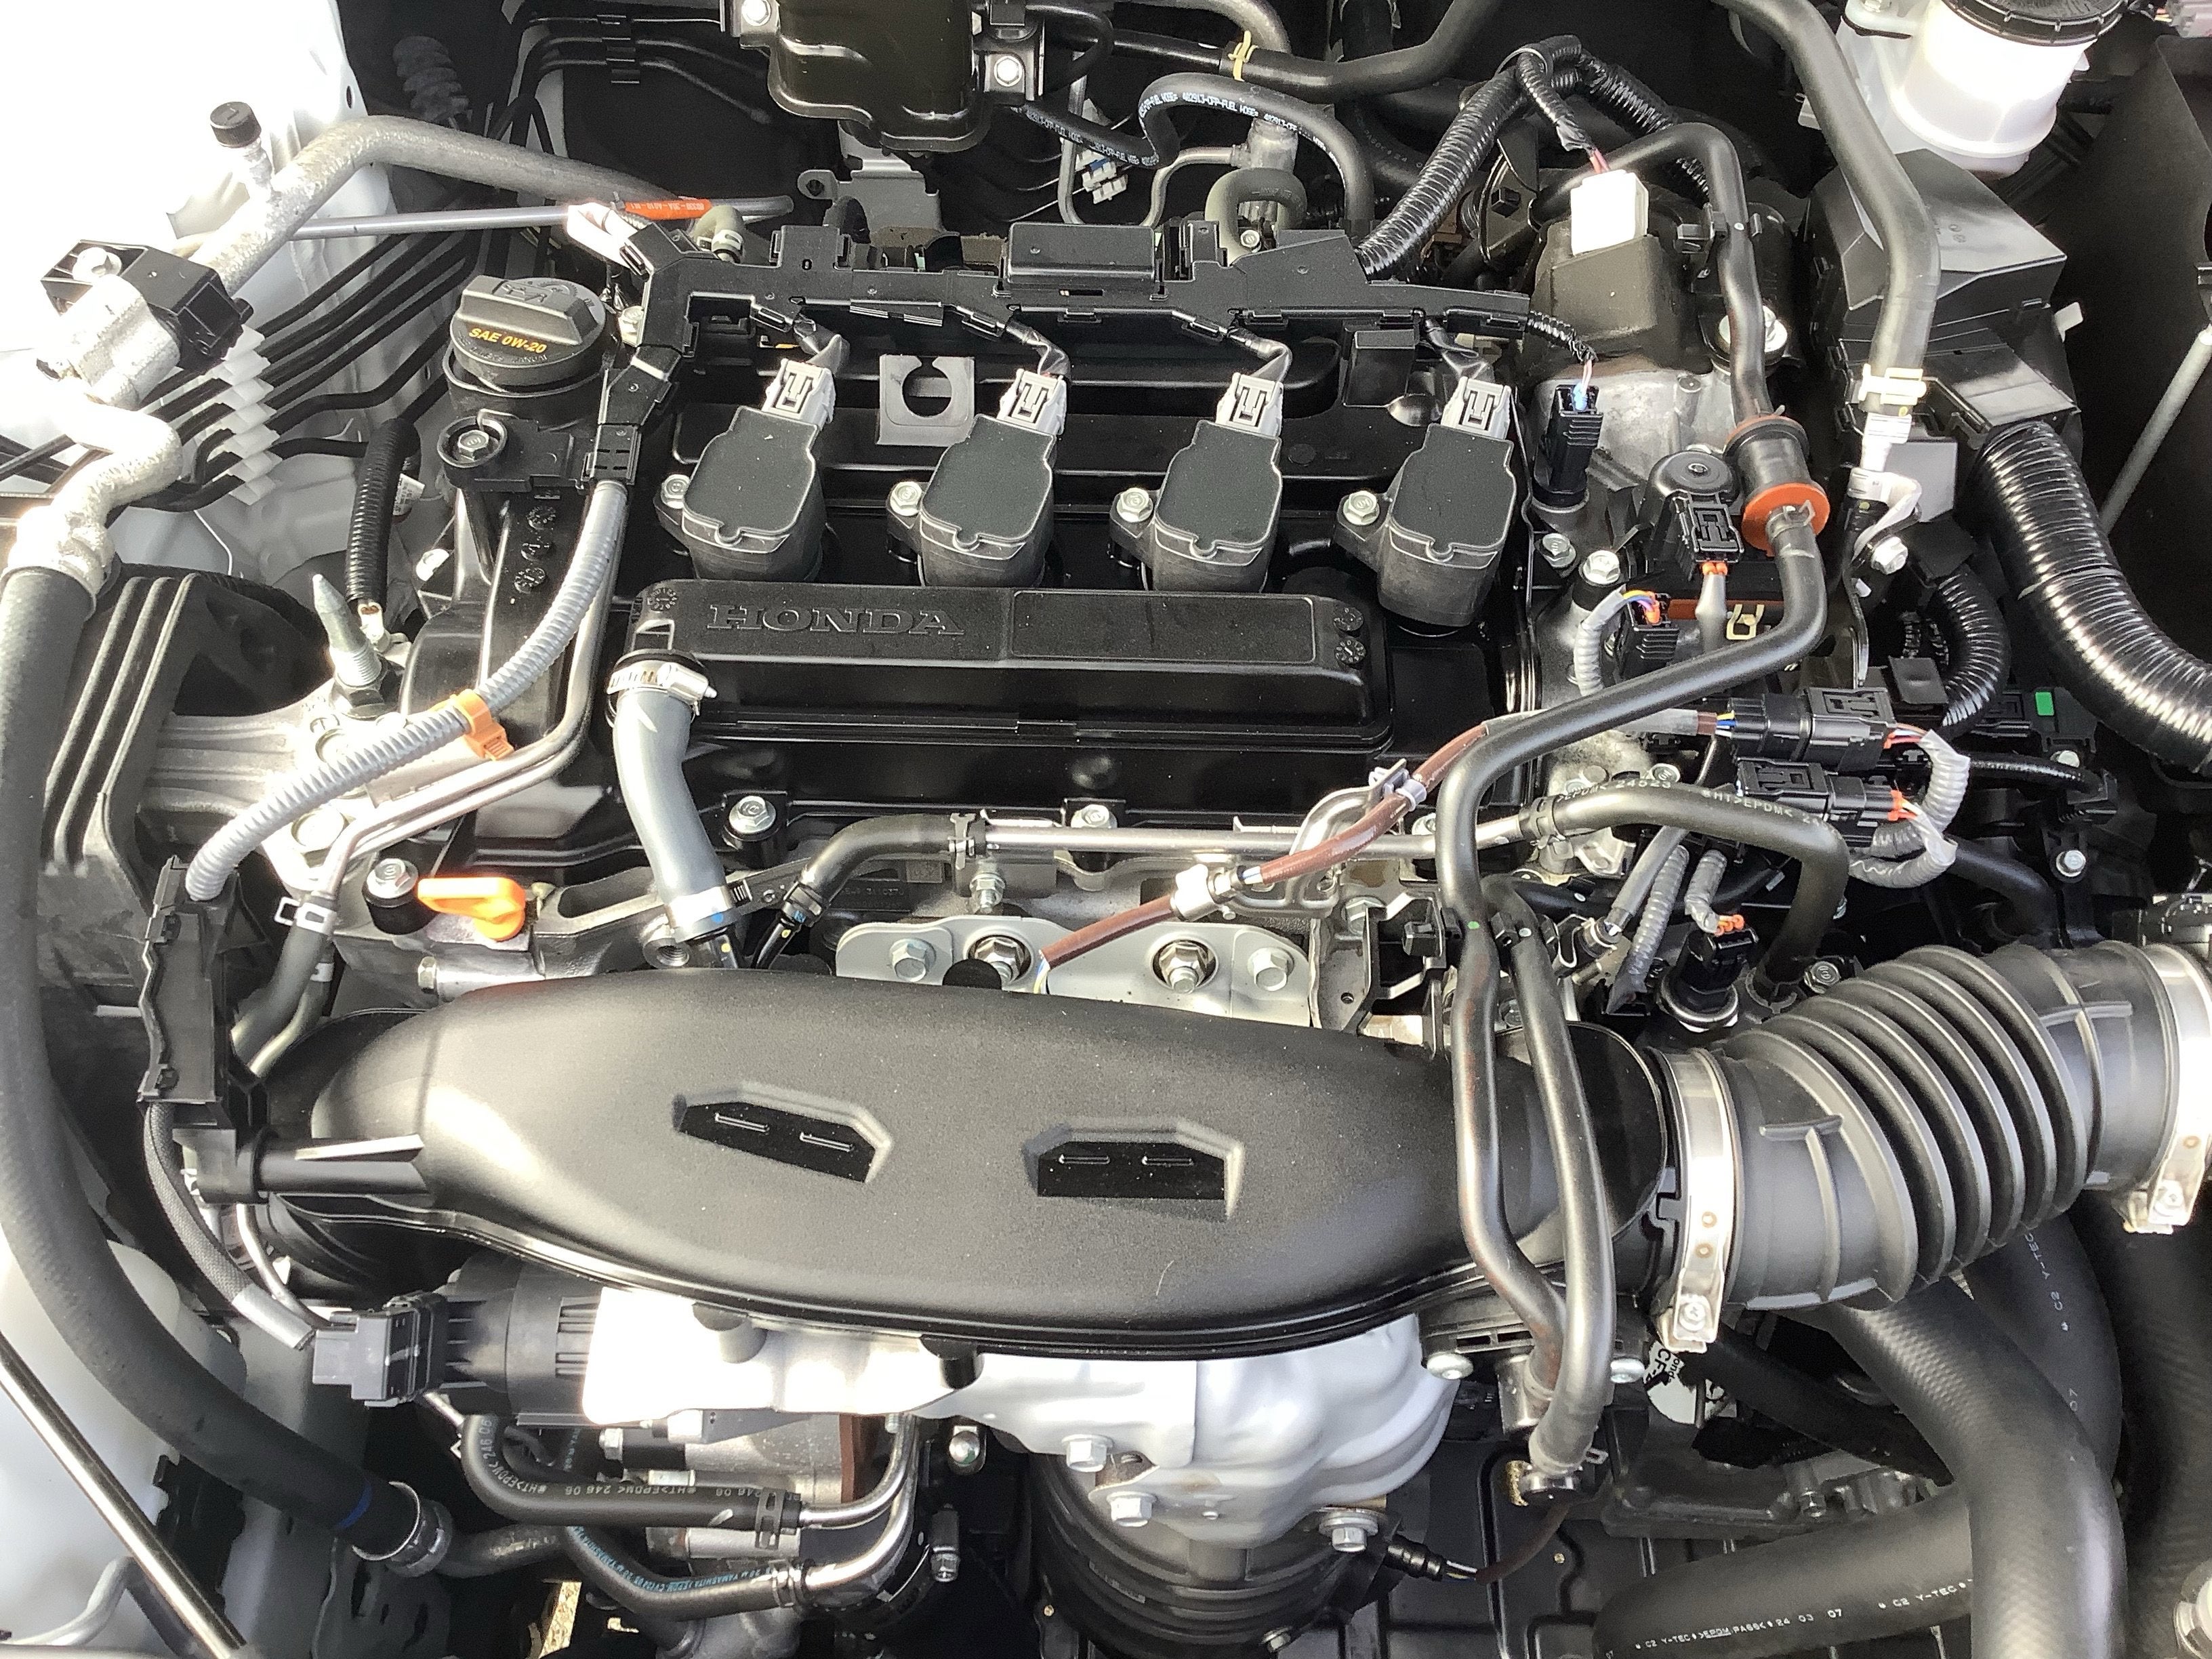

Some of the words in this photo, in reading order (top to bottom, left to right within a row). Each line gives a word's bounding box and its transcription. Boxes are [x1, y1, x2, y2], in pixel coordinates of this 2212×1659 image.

[468, 328, 502, 343] SAE
[501, 335, 548, 354] 0W-20
[707, 604, 965, 635] HONDA
[2024, 1232, 2051, 1280] Y-TEC
[2050, 1290, 2064, 1311] C2
[1660, 1634, 1692, 1645] Y-TEC
[1827, 1608, 1843, 1618] 07
[1893, 1597, 1911, 1608] C2
[1914, 1585, 1958, 1602] Y-TEC
